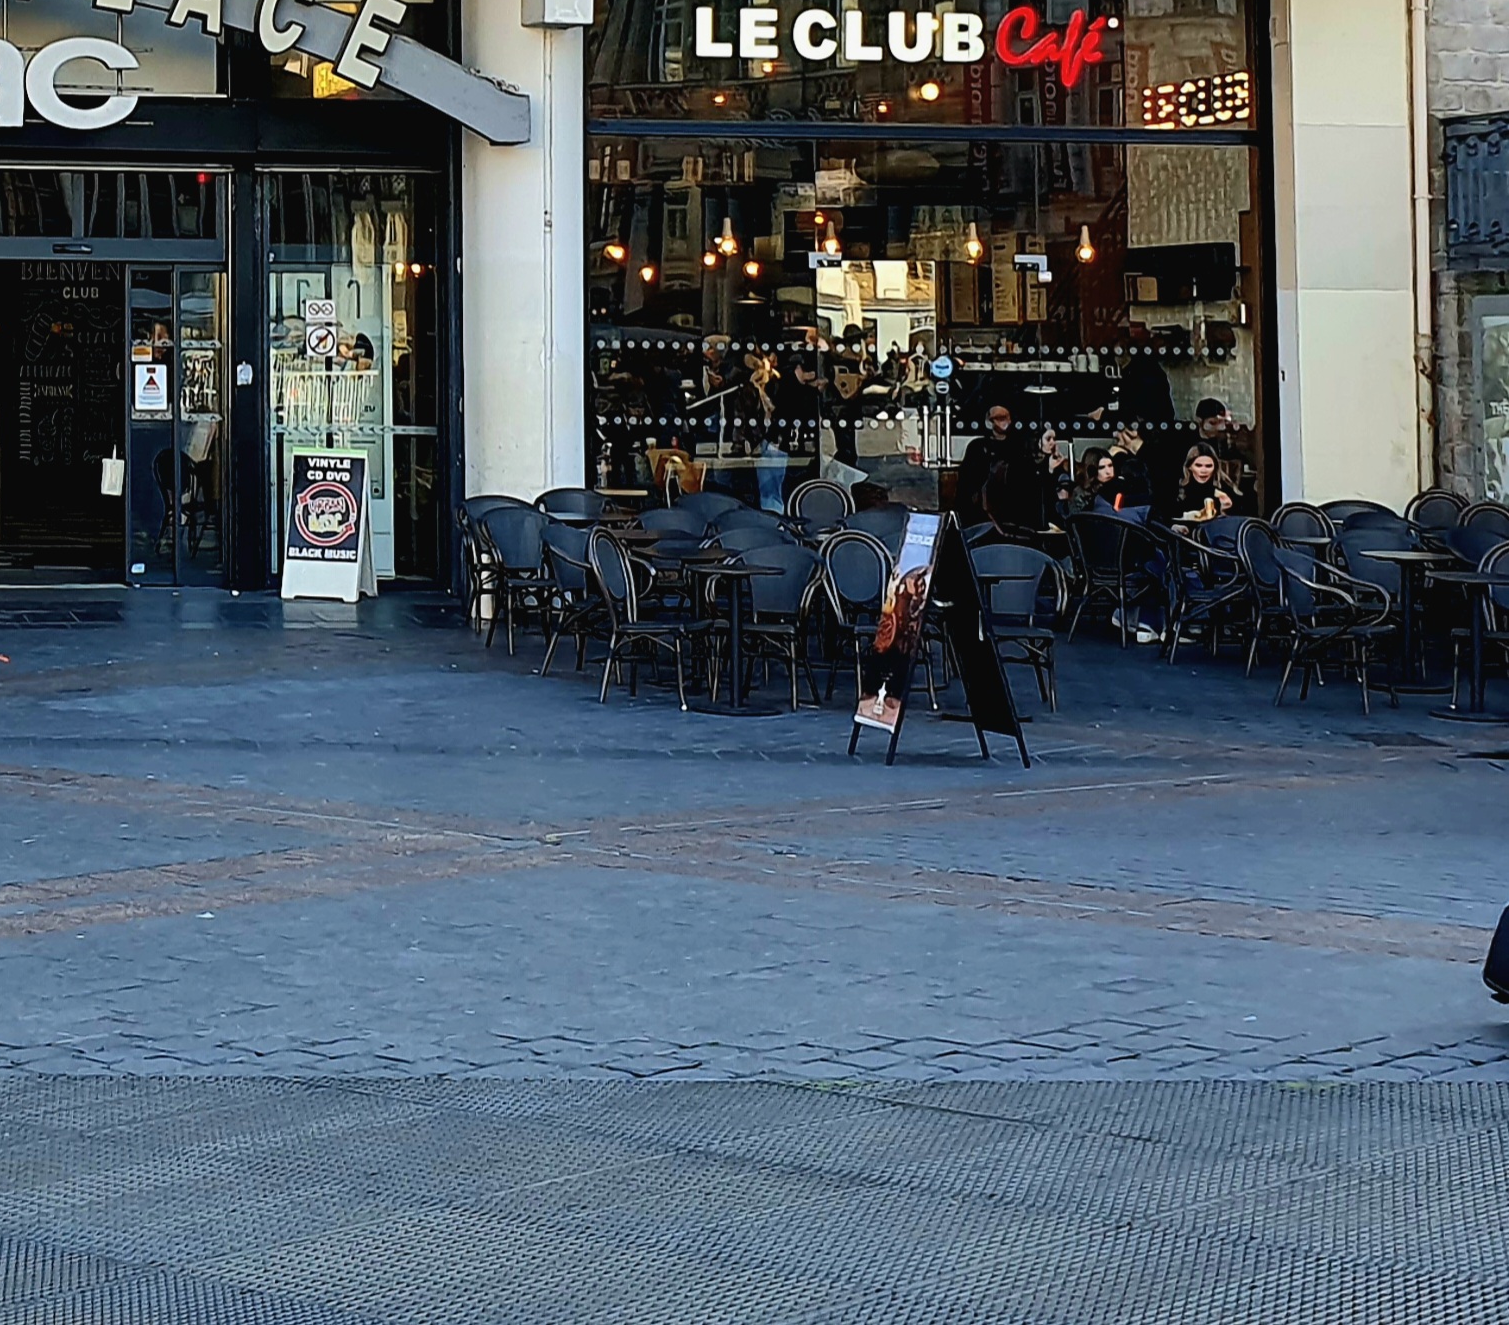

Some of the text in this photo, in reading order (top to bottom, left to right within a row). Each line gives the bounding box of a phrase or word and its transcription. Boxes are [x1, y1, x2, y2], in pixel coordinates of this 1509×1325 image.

[694, 5, 1106, 88] LE CLUB Café
[62, 286, 99, 299] CLUB
[307, 457, 351, 470] VINYLE
[306, 469, 351, 482] CD DVD
[288, 546, 357, 560] BLACK MUSIC
